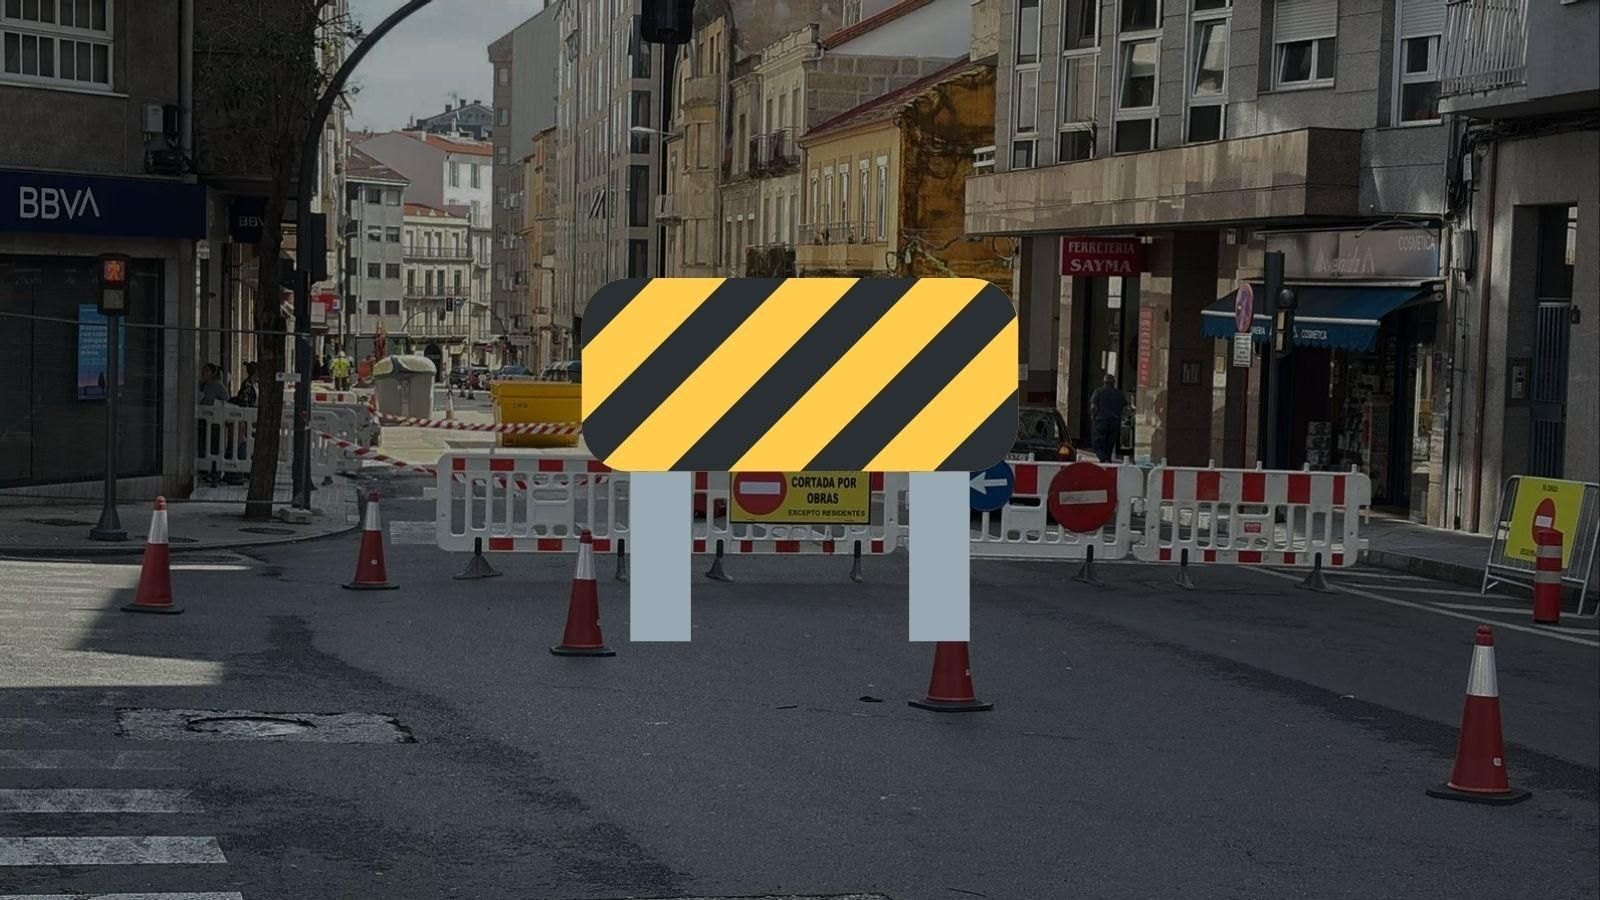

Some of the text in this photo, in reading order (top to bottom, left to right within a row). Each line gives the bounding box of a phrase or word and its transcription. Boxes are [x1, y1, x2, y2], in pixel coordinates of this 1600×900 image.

[19, 186, 101, 220] BBVA
[239, 215, 264, 228] BBV
[1068, 241, 1135, 255] FERRETERIA
[1070, 258, 1132, 273] SAYMA
[791, 476, 857, 489] CORTADA POR
[807, 492, 839, 505] OBRAS
[788, 509, 866, 518] EXCEPTO RESIDENTES
